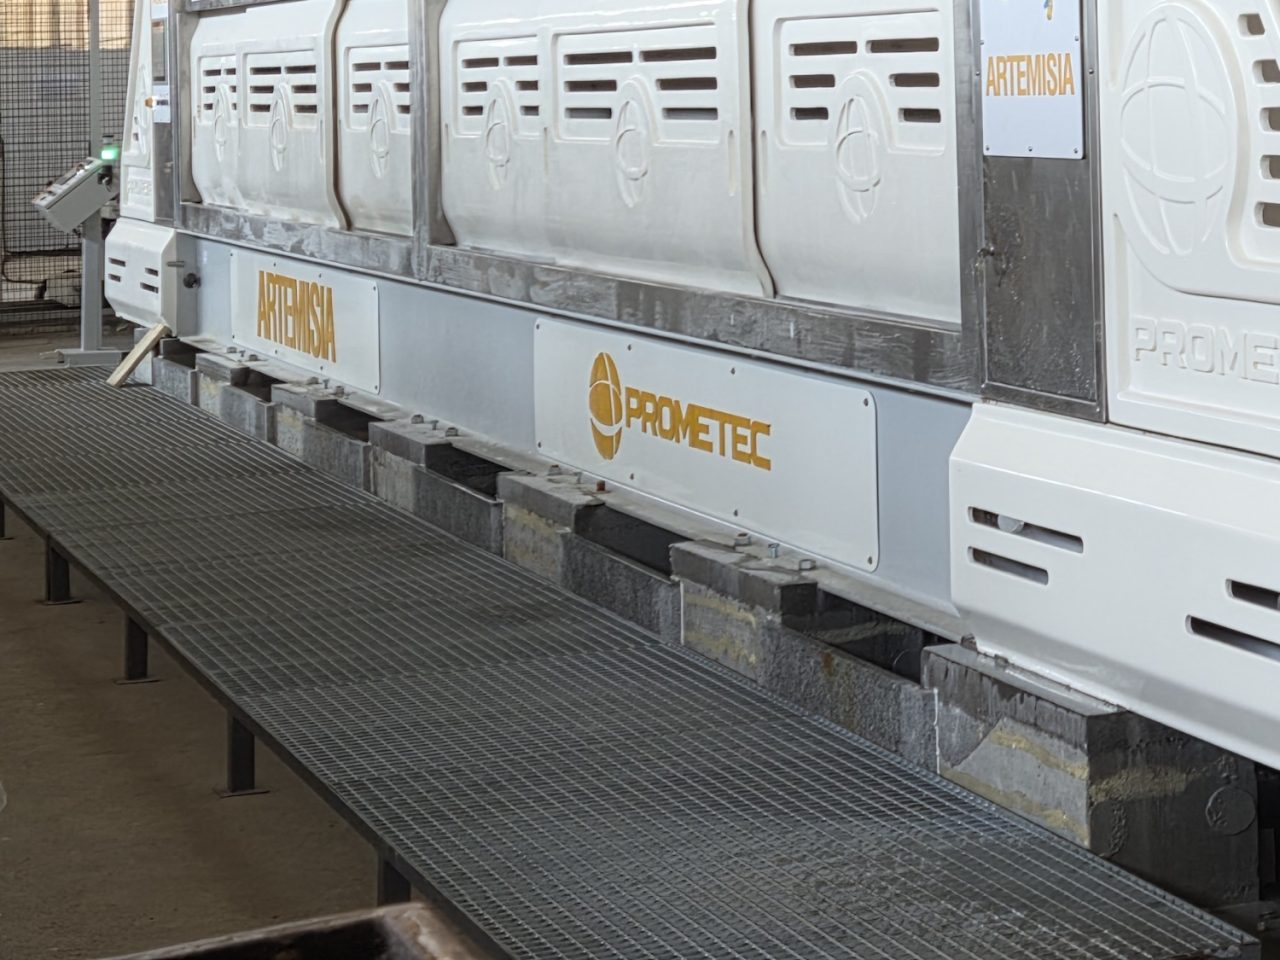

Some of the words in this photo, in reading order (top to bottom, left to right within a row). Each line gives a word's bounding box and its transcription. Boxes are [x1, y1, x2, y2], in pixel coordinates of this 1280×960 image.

[985, 53, 1075, 96] ARTEMISIA
[257, 270, 336, 363] ARTEMISIA
[625, 386, 771, 471] PROMETEC
